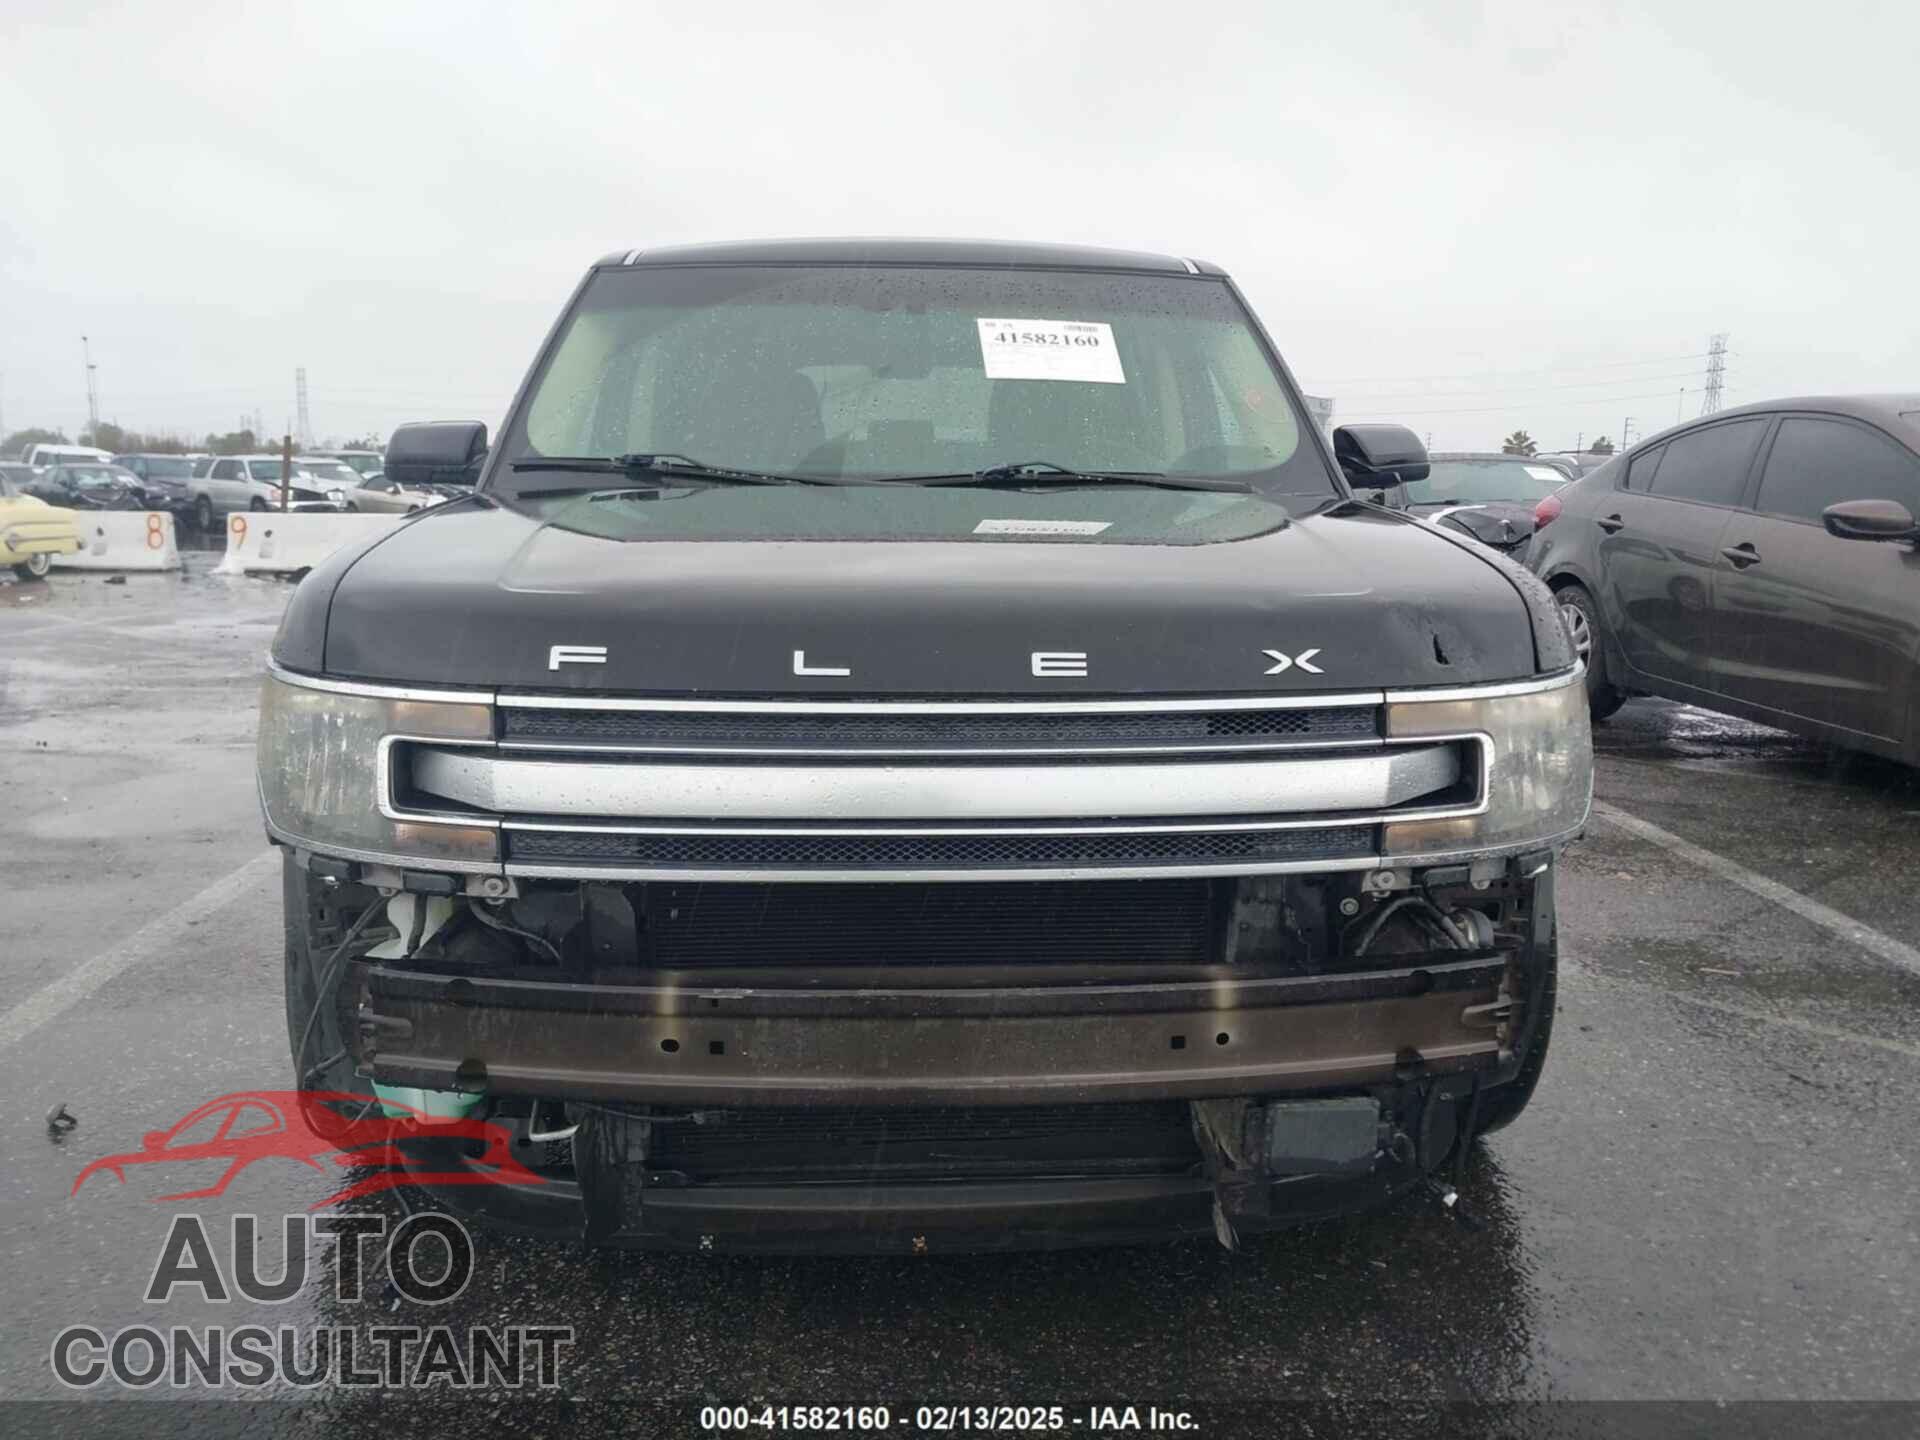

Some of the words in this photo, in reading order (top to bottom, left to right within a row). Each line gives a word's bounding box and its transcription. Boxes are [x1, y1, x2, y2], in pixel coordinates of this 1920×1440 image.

[994, 331, 1100, 348] 41582160
[147, 513, 164, 549] 8
[231, 516, 247, 550] 9
[549, 645, 1325, 677] FLEX
